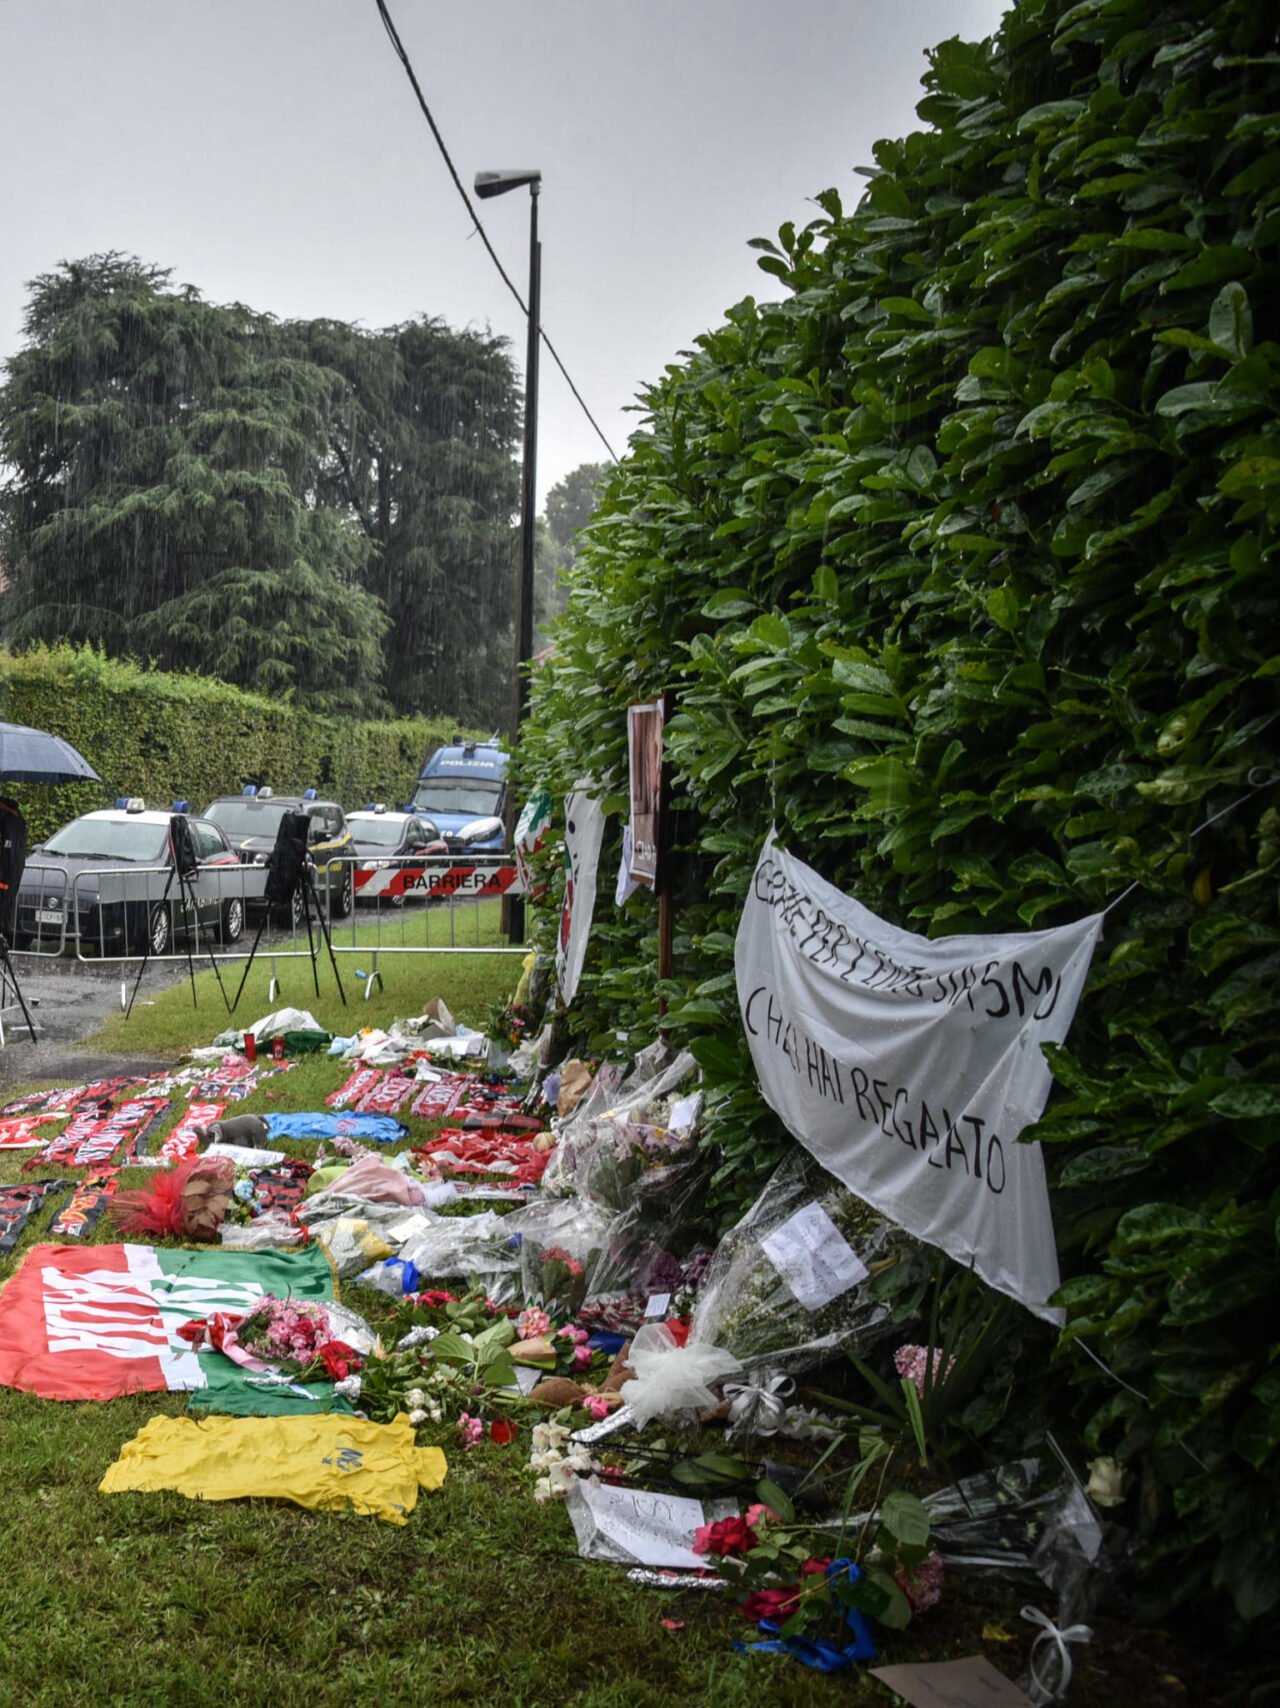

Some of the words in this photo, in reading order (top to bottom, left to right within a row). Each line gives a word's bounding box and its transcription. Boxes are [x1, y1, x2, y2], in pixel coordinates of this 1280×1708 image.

[440, 759, 495, 768] POLIZIA
[402, 873, 502, 890] BARRIERA
[799, 909, 852, 967] PER
[805, 1037, 845, 1105] HAI
[851, 1066, 1006, 1195] REGALATO
